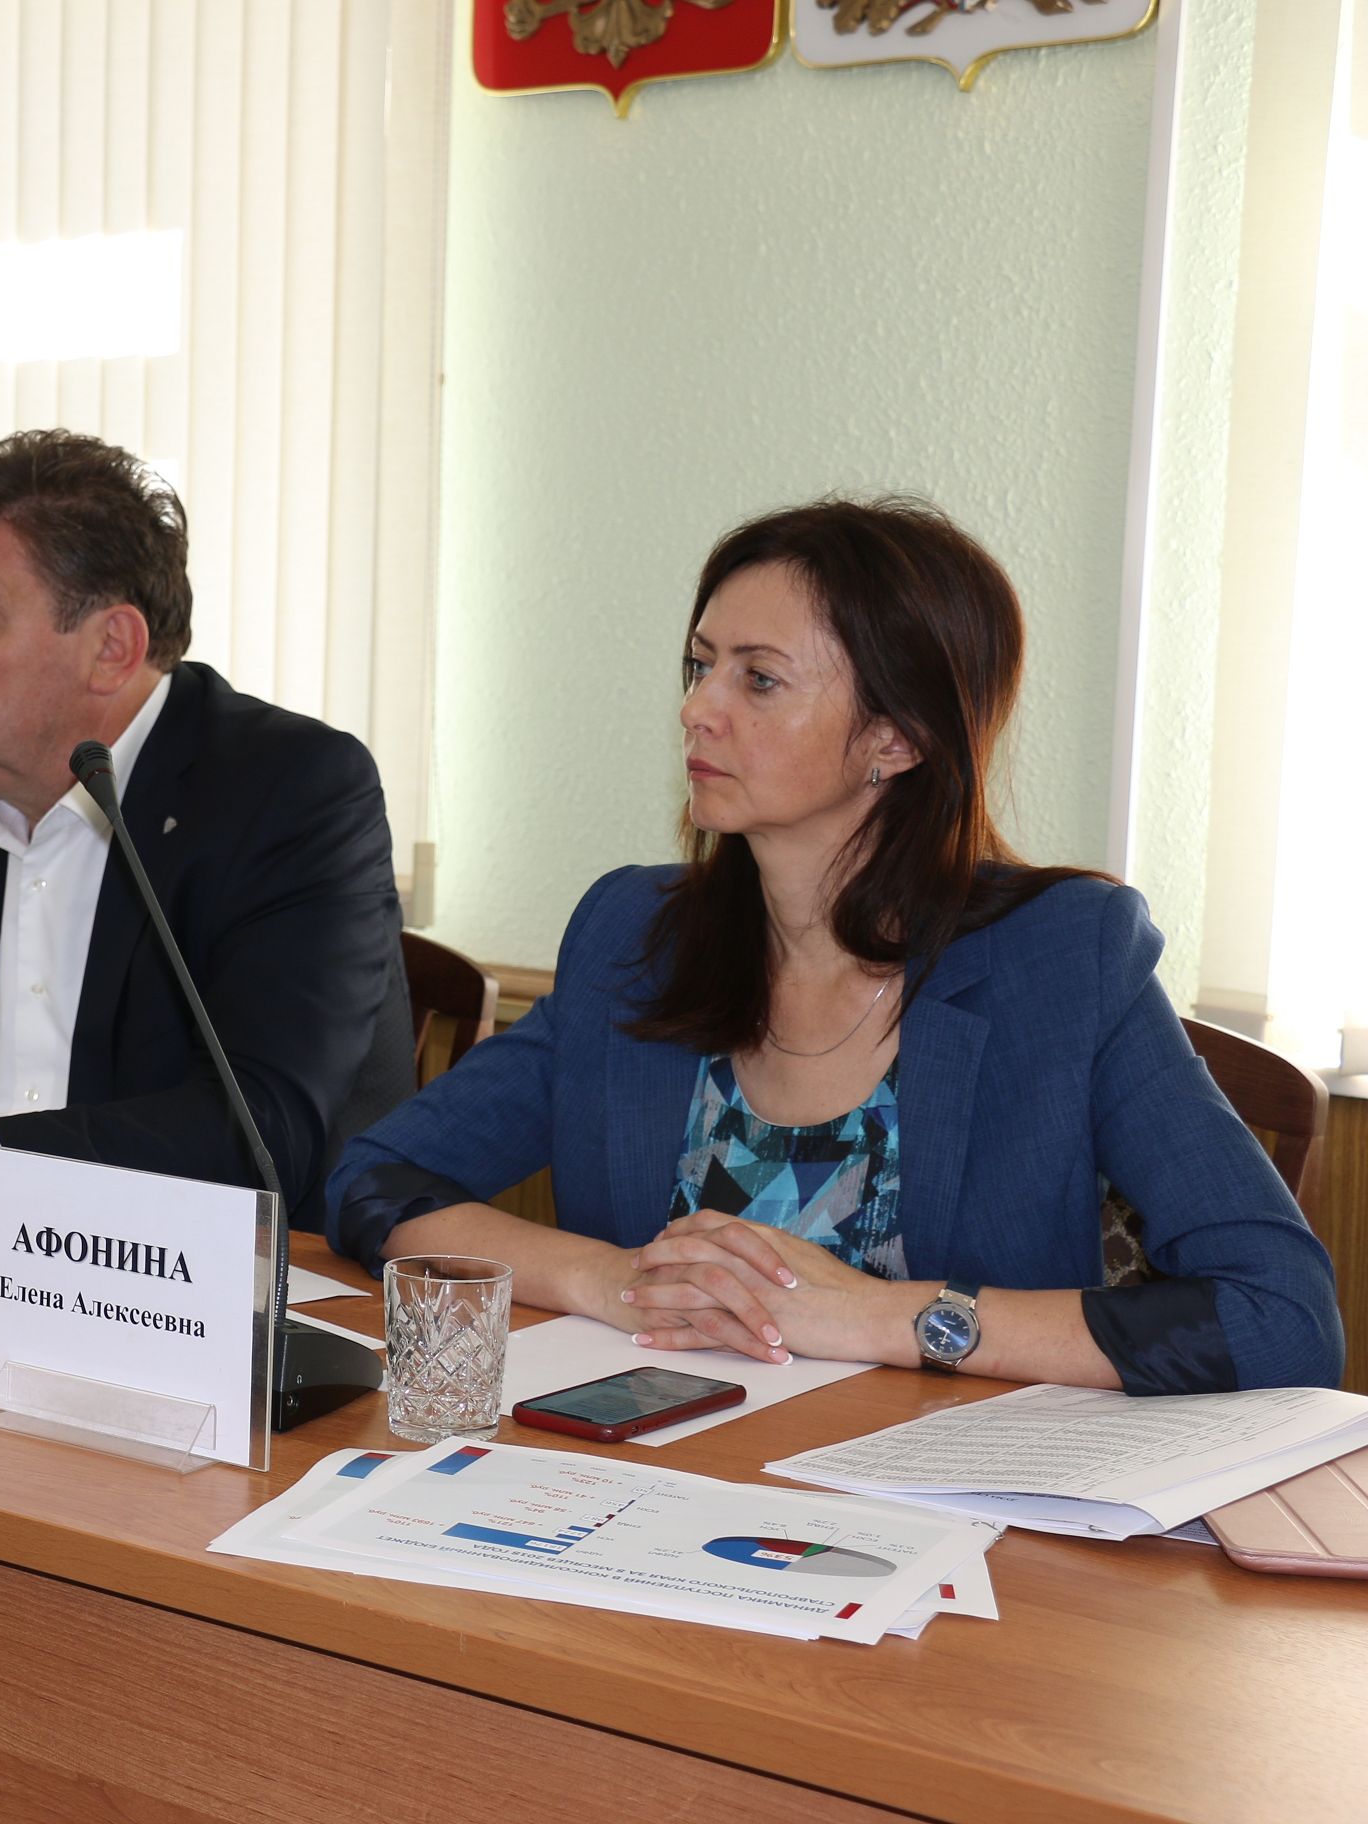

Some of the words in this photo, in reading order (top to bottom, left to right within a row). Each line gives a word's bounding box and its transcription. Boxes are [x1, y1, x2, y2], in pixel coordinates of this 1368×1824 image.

[10, 1221, 194, 1284] АФОНИНА
[70, 1291, 206, 1339] Алексеевна
[375, 1535, 439, 1550] БЮДЖЕТ
[473, 1544, 510, 1555] ГОДА
[439, 1546, 609, 1579] КОНСОЛИДИРОВАННЫЙ
[510, 1551, 545, 1562] 2018
[546, 1557, 614, 1572] МЕСЯЦЕВ
[623, 1577, 735, 1599] ПОСТУПЛЕНИЙ
[648, 1573, 688, 1583] КРАЯ
[689, 1580, 836, 1607] СТАВРОПОЛЬСКОГО
[737, 1594, 831, 1614] ДИНАМИКА
